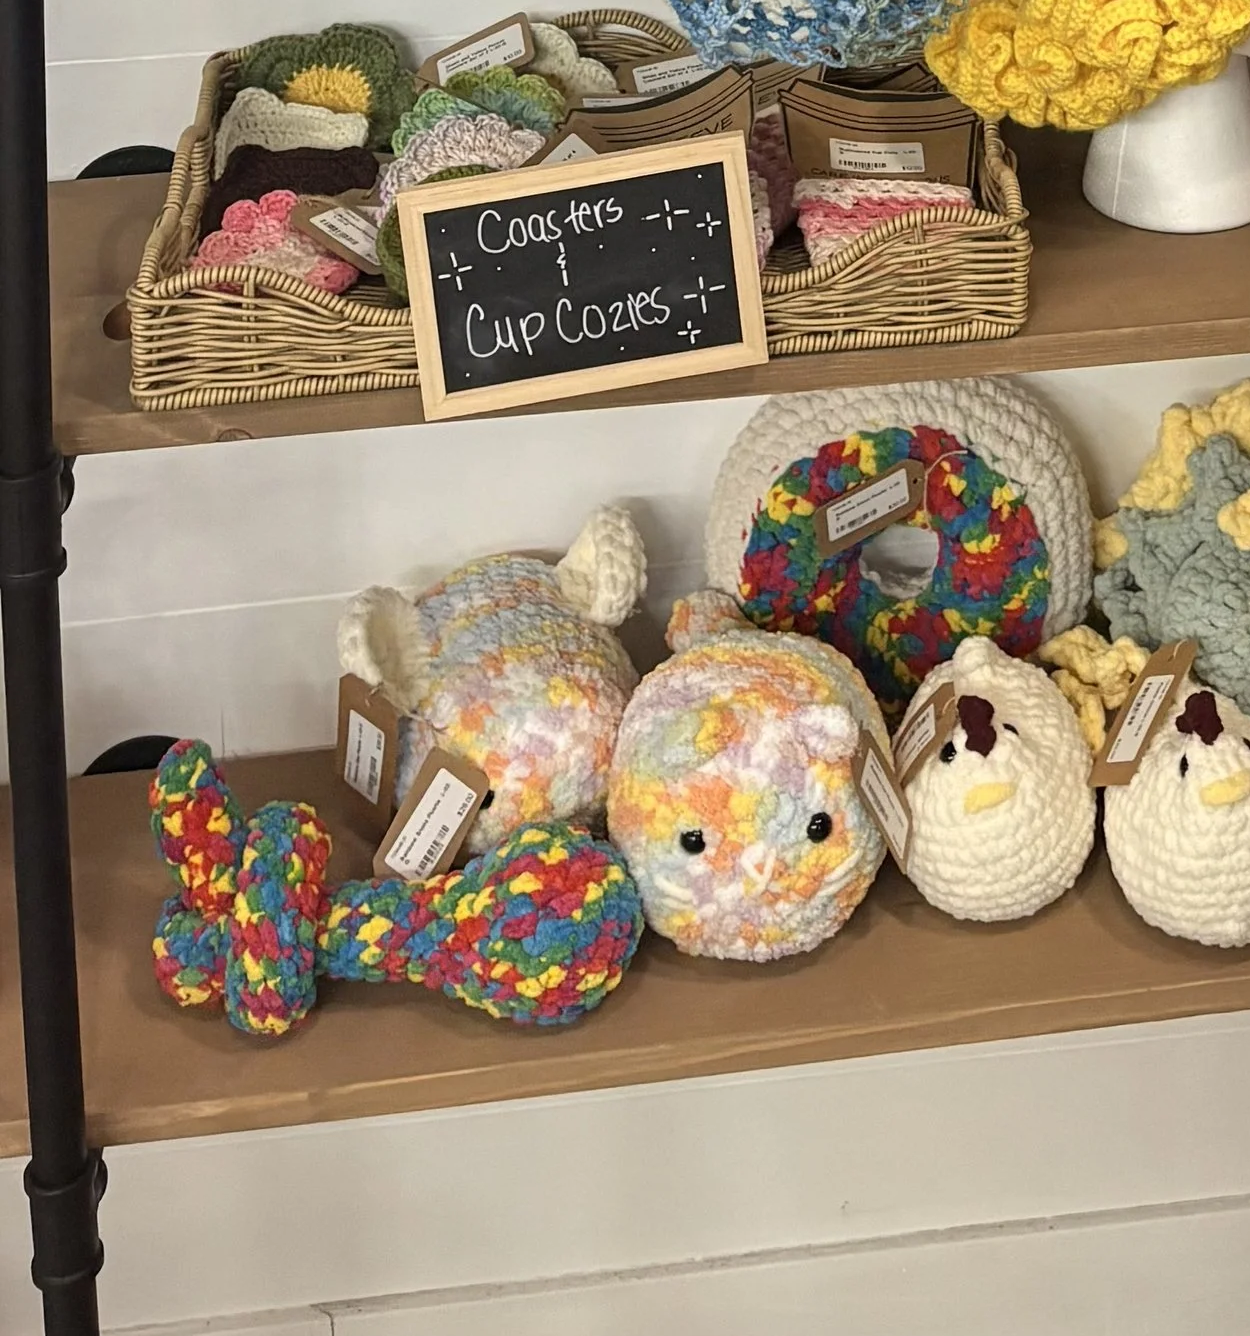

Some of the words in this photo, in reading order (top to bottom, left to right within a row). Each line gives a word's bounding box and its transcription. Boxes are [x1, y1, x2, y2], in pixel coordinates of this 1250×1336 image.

[478, 198, 624, 254] Coasters
[467, 303, 544, 358] Cup
[556, 285, 671, 343] Cozies
